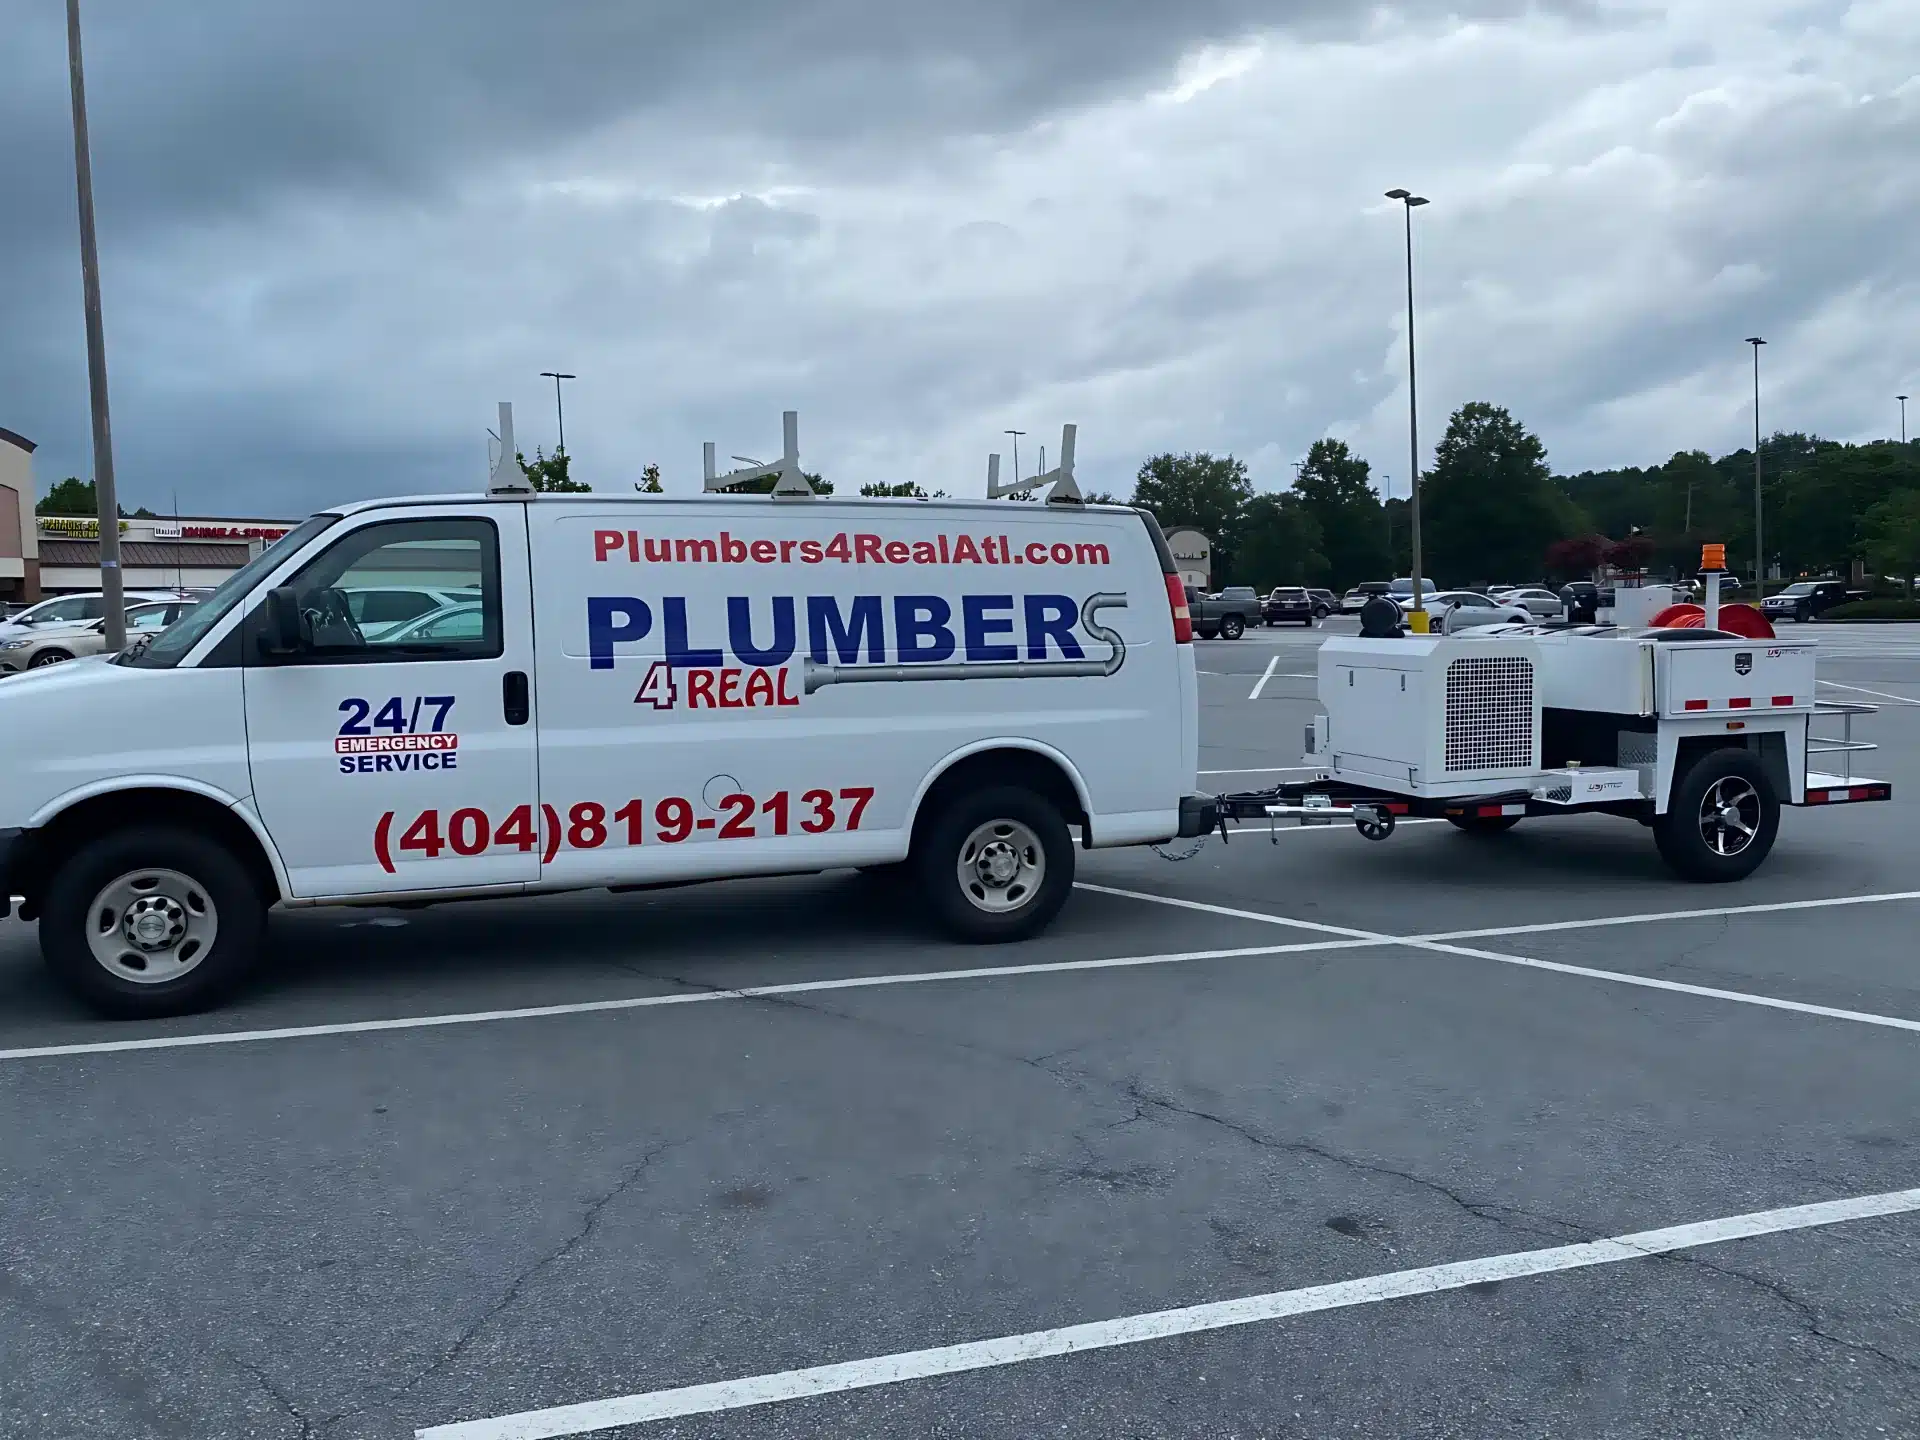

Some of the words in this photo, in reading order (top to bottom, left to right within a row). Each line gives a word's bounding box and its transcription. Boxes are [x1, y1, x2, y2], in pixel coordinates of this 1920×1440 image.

[594, 530, 1110, 565] Plumbers4RealAtl.com
[587, 592, 1128, 670] PLUMBERS
[634, 660, 678, 710] 4
[687, 665, 800, 710] REAL
[338, 695, 456, 736] 24/7
[337, 735, 457, 752] EMERGENCY
[339, 752, 457, 774] SERVICE
[374, 786, 875, 873] (404)819-2137
